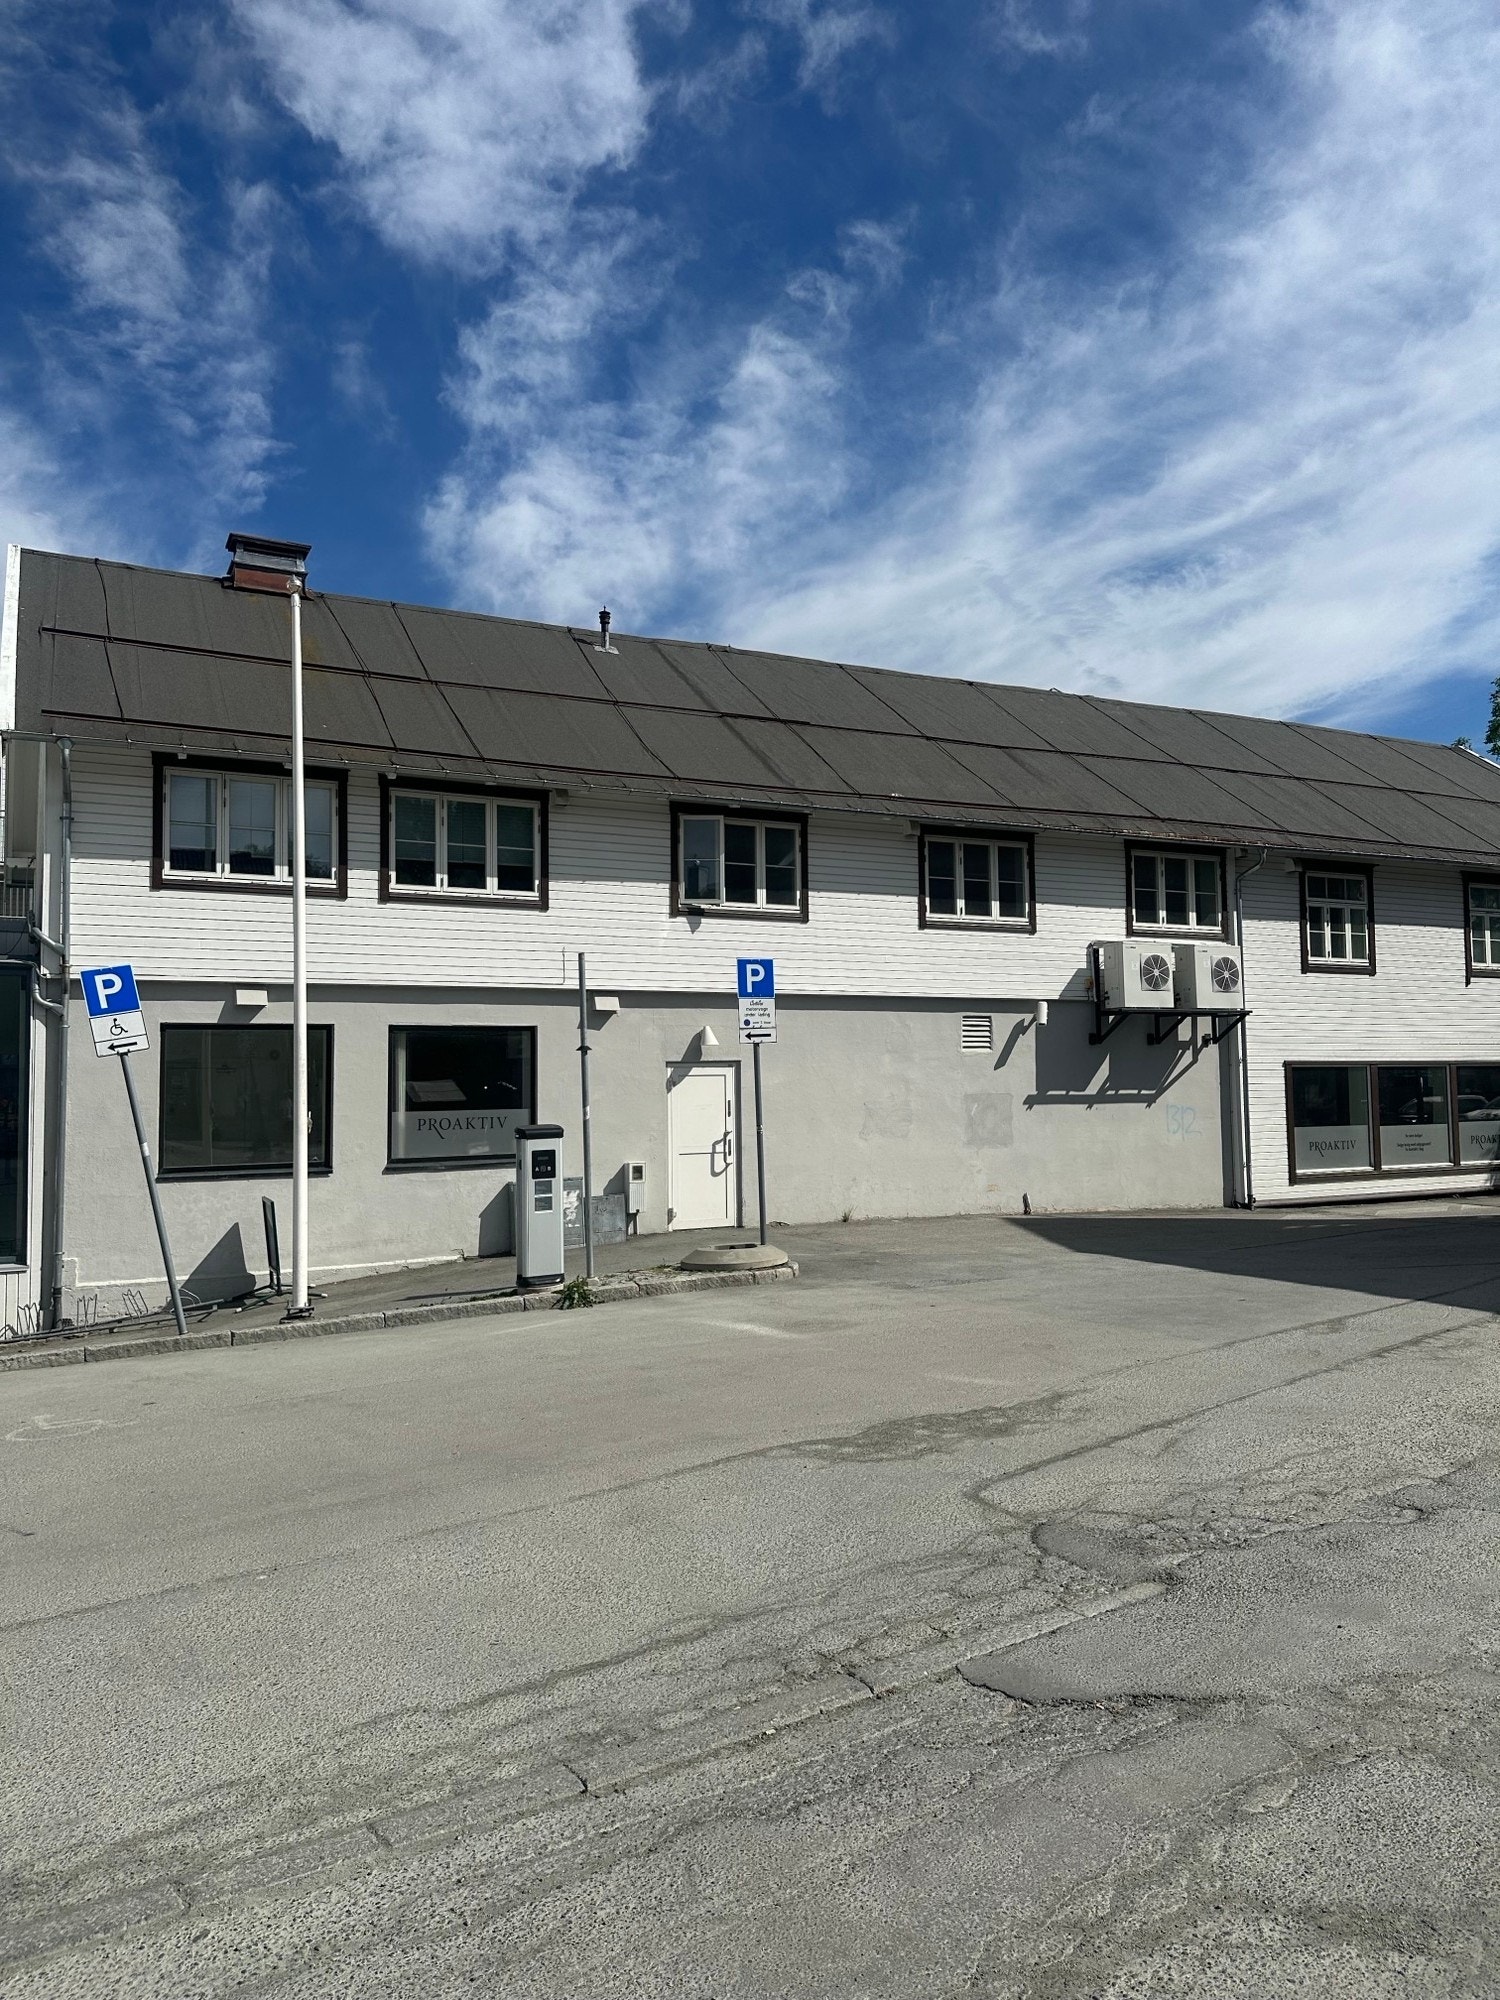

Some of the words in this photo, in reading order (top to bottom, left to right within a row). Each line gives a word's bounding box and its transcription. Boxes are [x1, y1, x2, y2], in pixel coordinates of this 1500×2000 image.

[93, 973, 123, 1009] P
[745, 963, 766, 993] P
[417, 1116, 508, 1140] PROAKTIV
[1308, 1139, 1357, 1158] PROAKTIV
